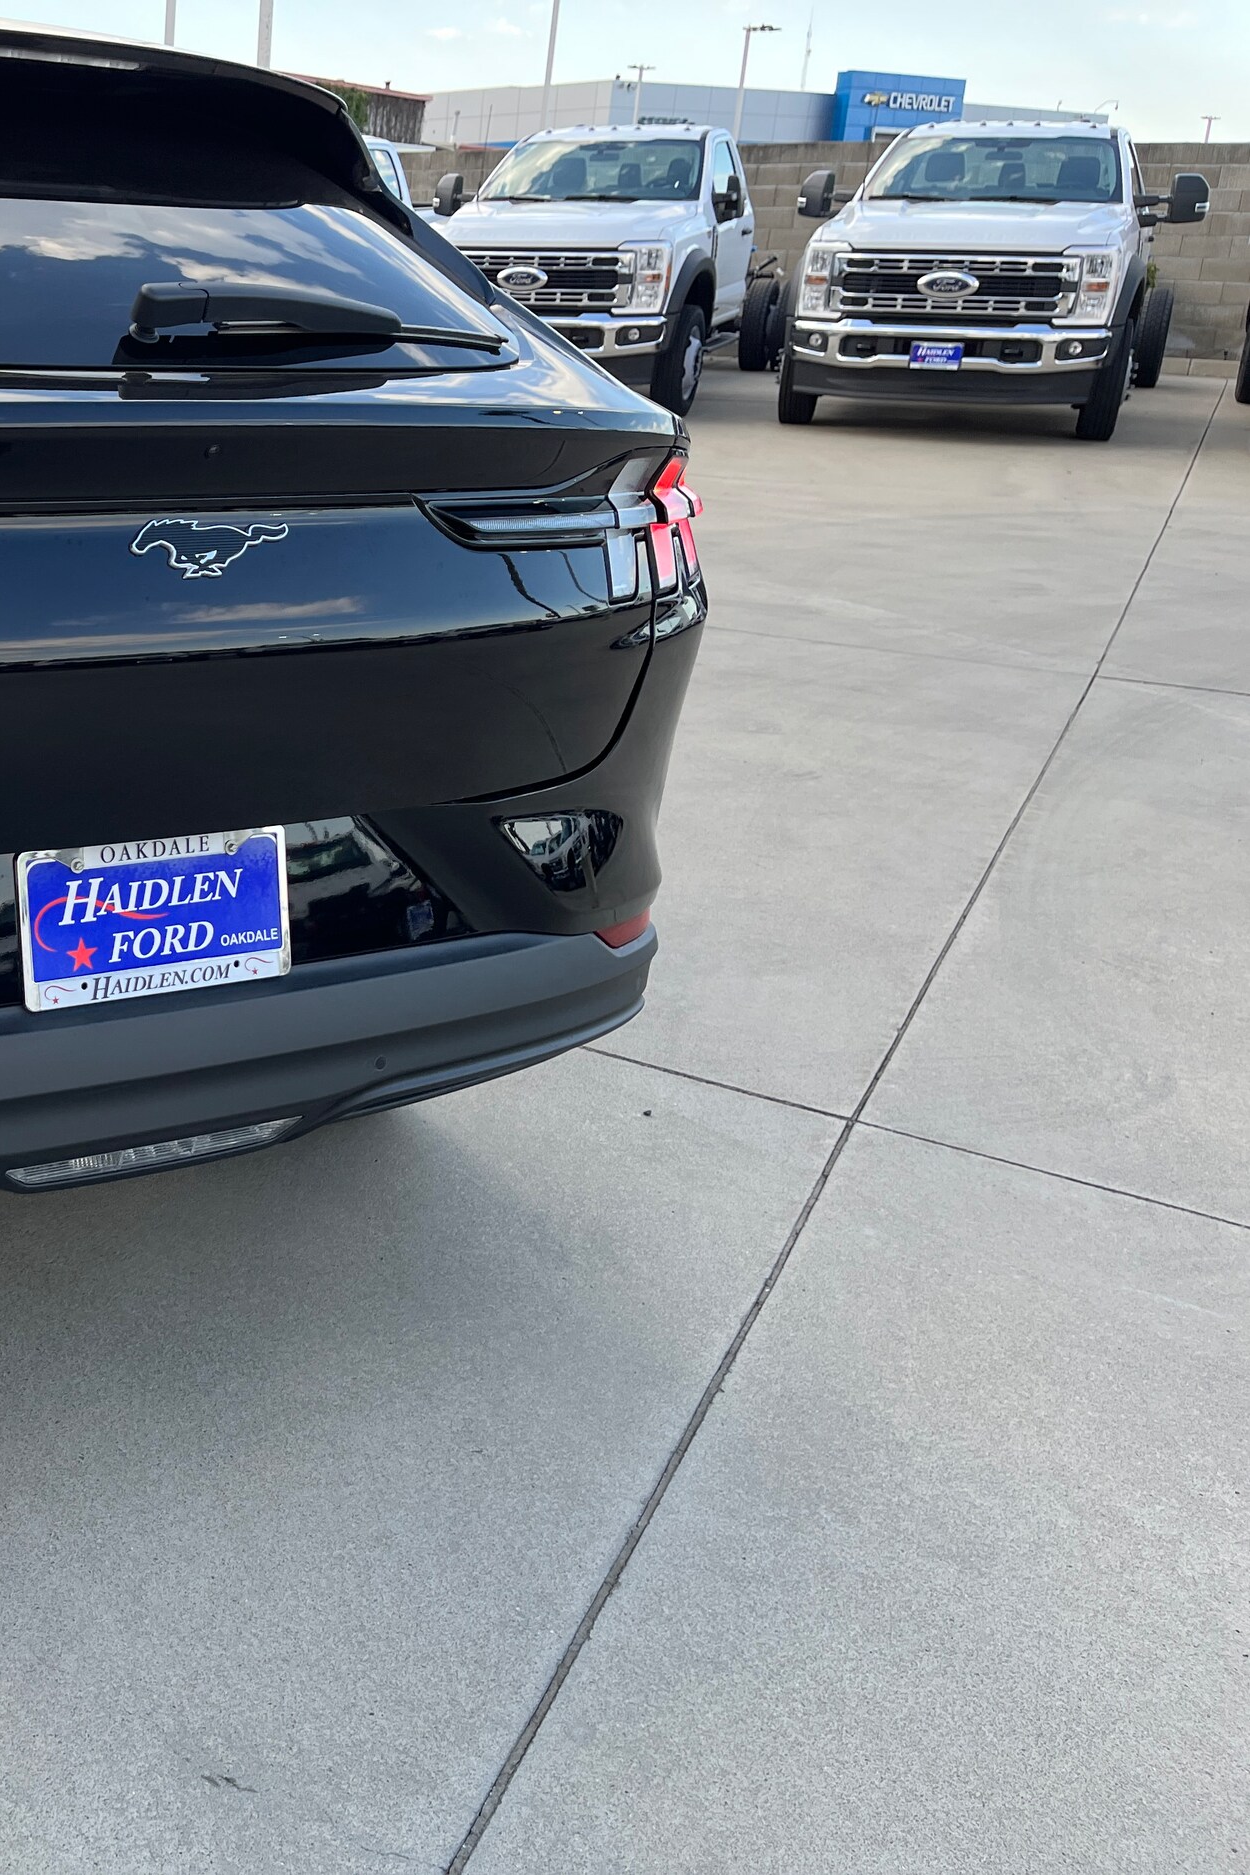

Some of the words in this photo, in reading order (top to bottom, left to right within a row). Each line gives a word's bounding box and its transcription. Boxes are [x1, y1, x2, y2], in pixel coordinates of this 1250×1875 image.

[889, 92, 955, 113] CHEVROLET
[100, 835, 210, 864] OAKDALE
[58, 868, 244, 926] HAIDLEN
[108, 921, 214, 963] FORD
[220, 927, 279, 948] OAKDALE
[91, 963, 231, 1001] HAIDLEN.COM
